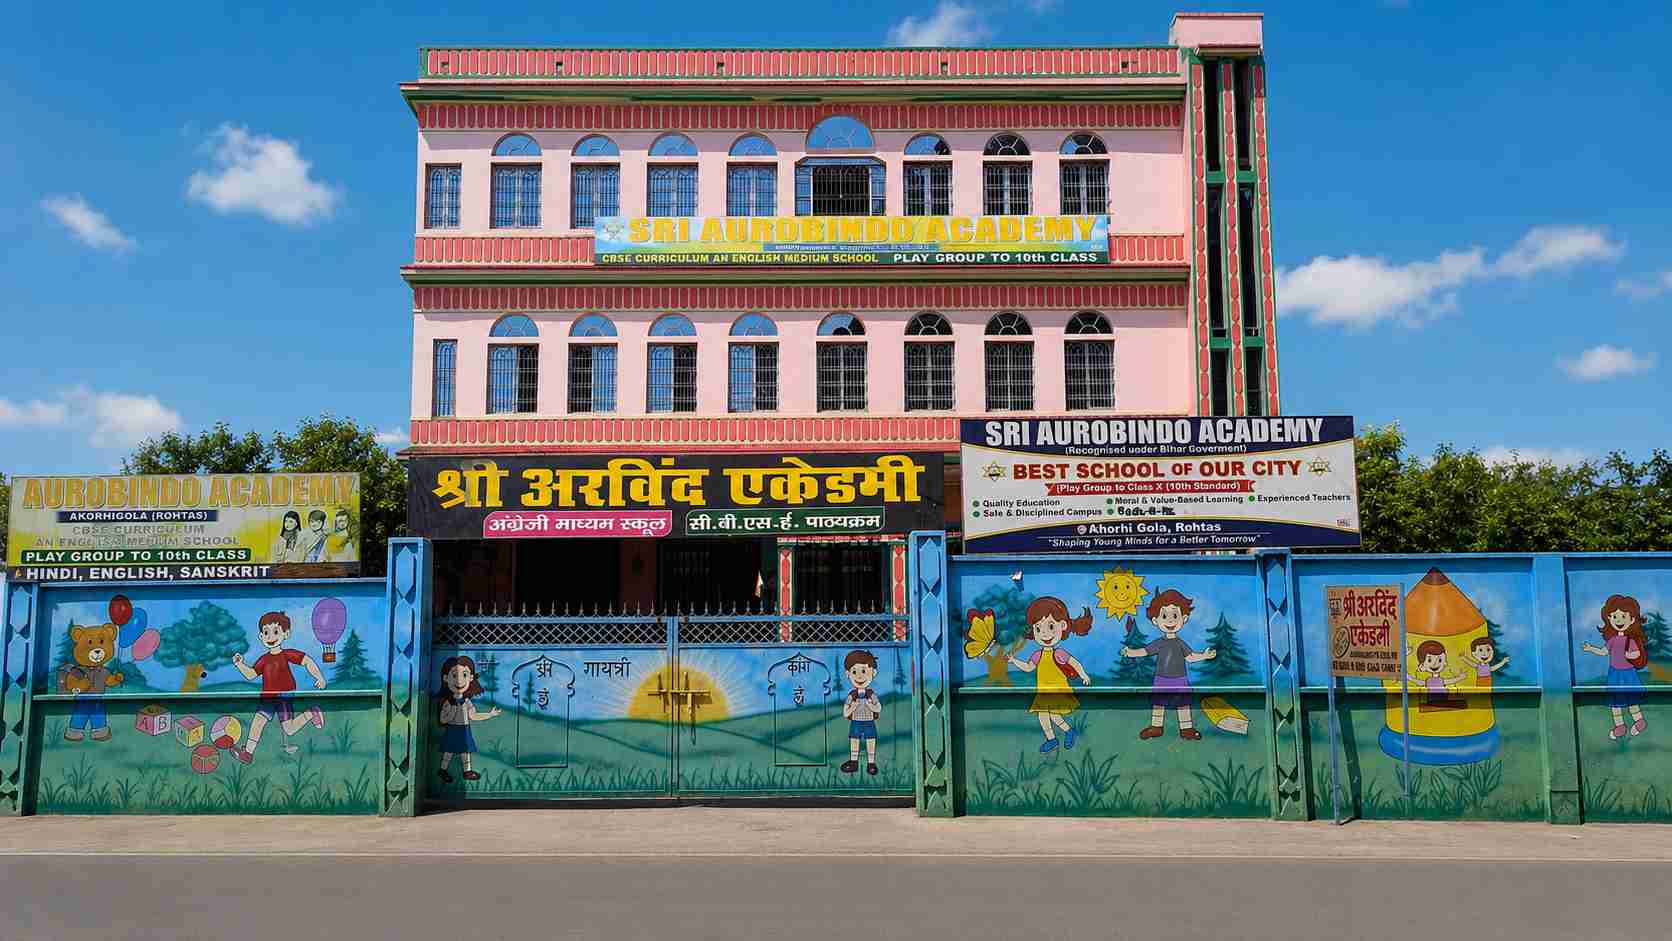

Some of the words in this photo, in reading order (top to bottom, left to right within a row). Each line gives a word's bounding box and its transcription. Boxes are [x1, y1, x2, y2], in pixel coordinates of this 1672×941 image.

[627, 216, 690, 242] SRI
[699, 216, 917, 242] AUROBINDO
[927, 215, 1097, 242] ACADEMY
[635, 254, 709, 263] CURRICULUM
[713, 254, 729, 263] AN
[732, 254, 781, 263] ENGLISH
[784, 254, 829, 263] MEDIUM
[833, 253, 879, 263] SCHOOL
[893, 253, 929, 263] PLAY
[935, 253, 985, 263] GROUP
[991, 253, 1010, 263] TO
[1015, 253, 1045, 263] 10th
[1050, 252, 1097, 263] CLASS
[985, 420, 1030, 446] SRI
[1036, 418, 1192, 446] AUROBINDO
[1198, 417, 1323, 444] ACADEMY
[1065, 446, 1126, 457] (Recognised
[1128, 446, 1157, 455] under
[1160, 445, 1187, 454] Bihar
[1013, 463, 1070, 480] BEST
[1076, 461, 1165, 480] SCHOOL
[1171, 463, 1193, 476] OF
[1200, 461, 1246, 477] OUR
[1252, 460, 1302, 476] CITY
[432, 457, 510, 509] श्री
[520, 456, 710, 508] अरविंद
[722, 454, 926, 505] एकेडमी
[1056, 483, 1081, 495] (Play
[1083, 482, 1112, 494] Group
[1115, 483, 1124, 492] to
[1127, 482, 1153, 492] Class
[1155, 482, 1162, 491] X
[1165, 481, 1192, 492] (10th
[1193, 480, 1241, 491] Standard)
[23, 476, 199, 509] AUROBINDO
[207, 473, 357, 508] ACADEMY
[982, 499, 1014, 510] Quality
[1016, 498, 1061, 508] Education
[1115, 496, 1139, 506] Moral
[1206, 495, 1244, 505] Learning
[1257, 494, 1311, 503] Experienced
[1312, 493, 1351, 502] Teachers
[151, 510, 208, 522] (ROHTAS)
[1006, 509, 1013, 517] &
[1015, 508, 1066, 520] Disciplined
[1066, 507, 1102, 518] Campus
[488, 514, 549, 532] अंग्रेजी
[619, 516, 667, 537] स्कूल
[805, 513, 881, 530] पाठ्यक्रम
[1136, 522, 1172, 535] Gola,
[1175, 521, 1222, 533] Rohtas
[183, 535, 241, 546] SCHOOL
[1093, 537, 1122, 548] Young
[1124, 536, 1153, 545] Minds
[1155, 536, 1169, 545] for
[1178, 535, 1208, 545] Better
[26, 551, 65, 562] PLAY
[71, 551, 125, 562] GROUP
[130, 550, 151, 561] TO
[158, 550, 191, 561] 10th
[196, 549, 247, 561] CLASS
[26, 567, 83, 581] HINDI,
[89, 566, 174, 581] ENGLISH,
[180, 565, 271, 579] SANSKRIT
